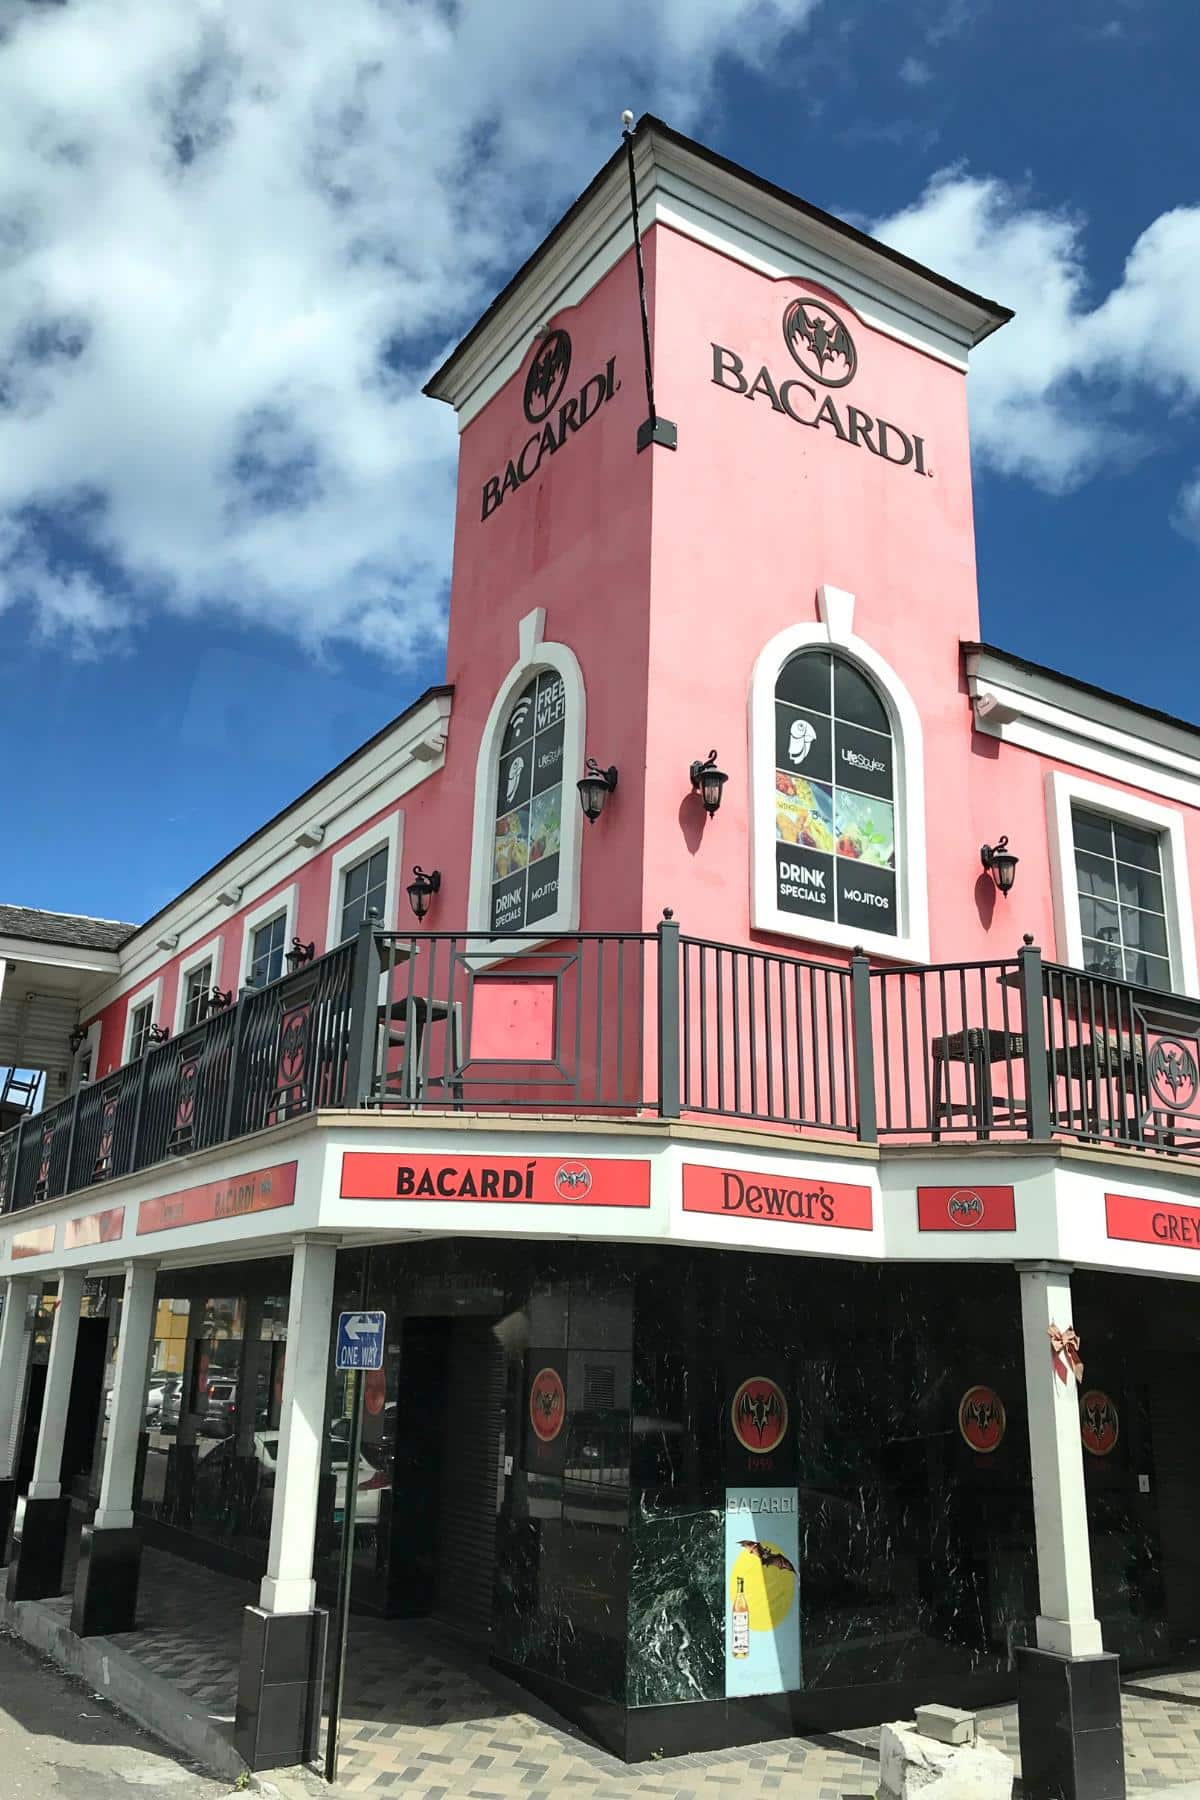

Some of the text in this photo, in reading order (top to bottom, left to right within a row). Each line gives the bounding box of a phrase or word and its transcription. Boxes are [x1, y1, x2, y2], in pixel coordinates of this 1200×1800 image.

[537, 681, 565, 711] FREE
[537, 697, 565, 728] WI-FI
[779, 861, 825, 889] DRINK
[495, 887, 522, 914] DRINK
[779, 883, 826, 904] SPECIALS
[843, 888, 889, 909] MOJITOS
[495, 907, 522, 928] SPECIALS
[396, 1160, 537, 1199] BACARDÍ
[721, 1172, 835, 1222] Dewar's
[1152, 1212, 1200, 1243] GREY
[341, 1345, 377, 1368] ONE WAY
